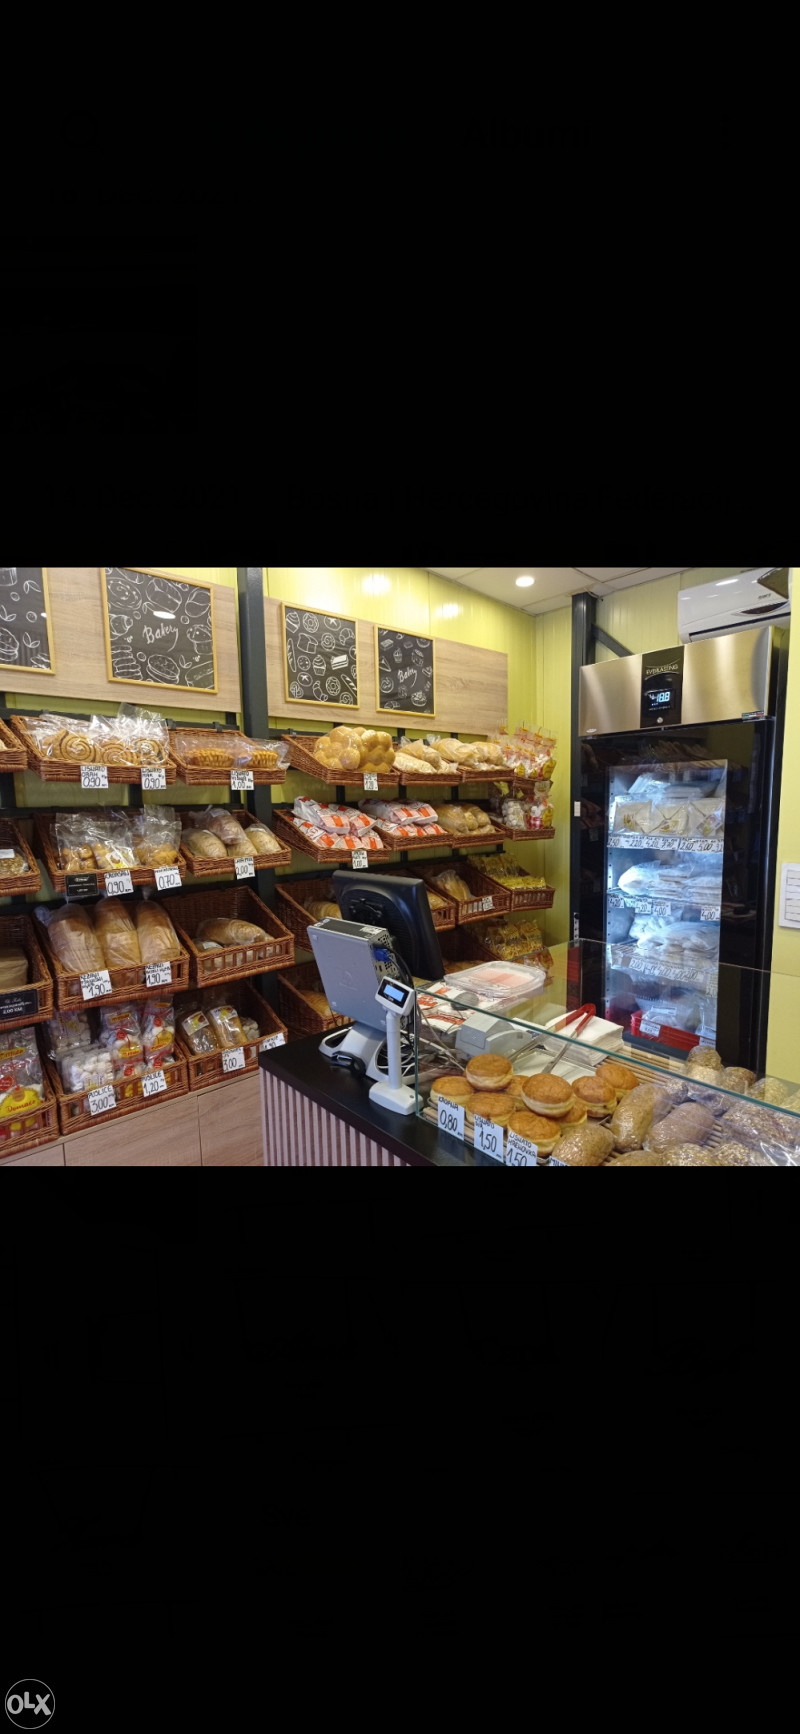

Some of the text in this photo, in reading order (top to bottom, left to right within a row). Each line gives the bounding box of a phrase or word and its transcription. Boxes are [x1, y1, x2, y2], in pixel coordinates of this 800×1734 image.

[142, 622, 179, 653] Bakery
[646, 664, 679, 675] EVERLASTING
[82, 777, 101, 787] 0,90
[144, 778, 160, 789] 0,90
[107, 880, 125, 894] 0,90
[159, 873, 175, 889] 0,70
[146, 973, 161, 985] 1,90
[88, 983, 106, 997] 1,90
[89, 1085, 112, 1099] PUSLICE
[143, 1081, 159, 1096] 1,20
[91, 1096, 109, 1114] 3,00
[440, 1109, 458, 1132] 0,80
[479, 1130, 498, 1153] 1,50
